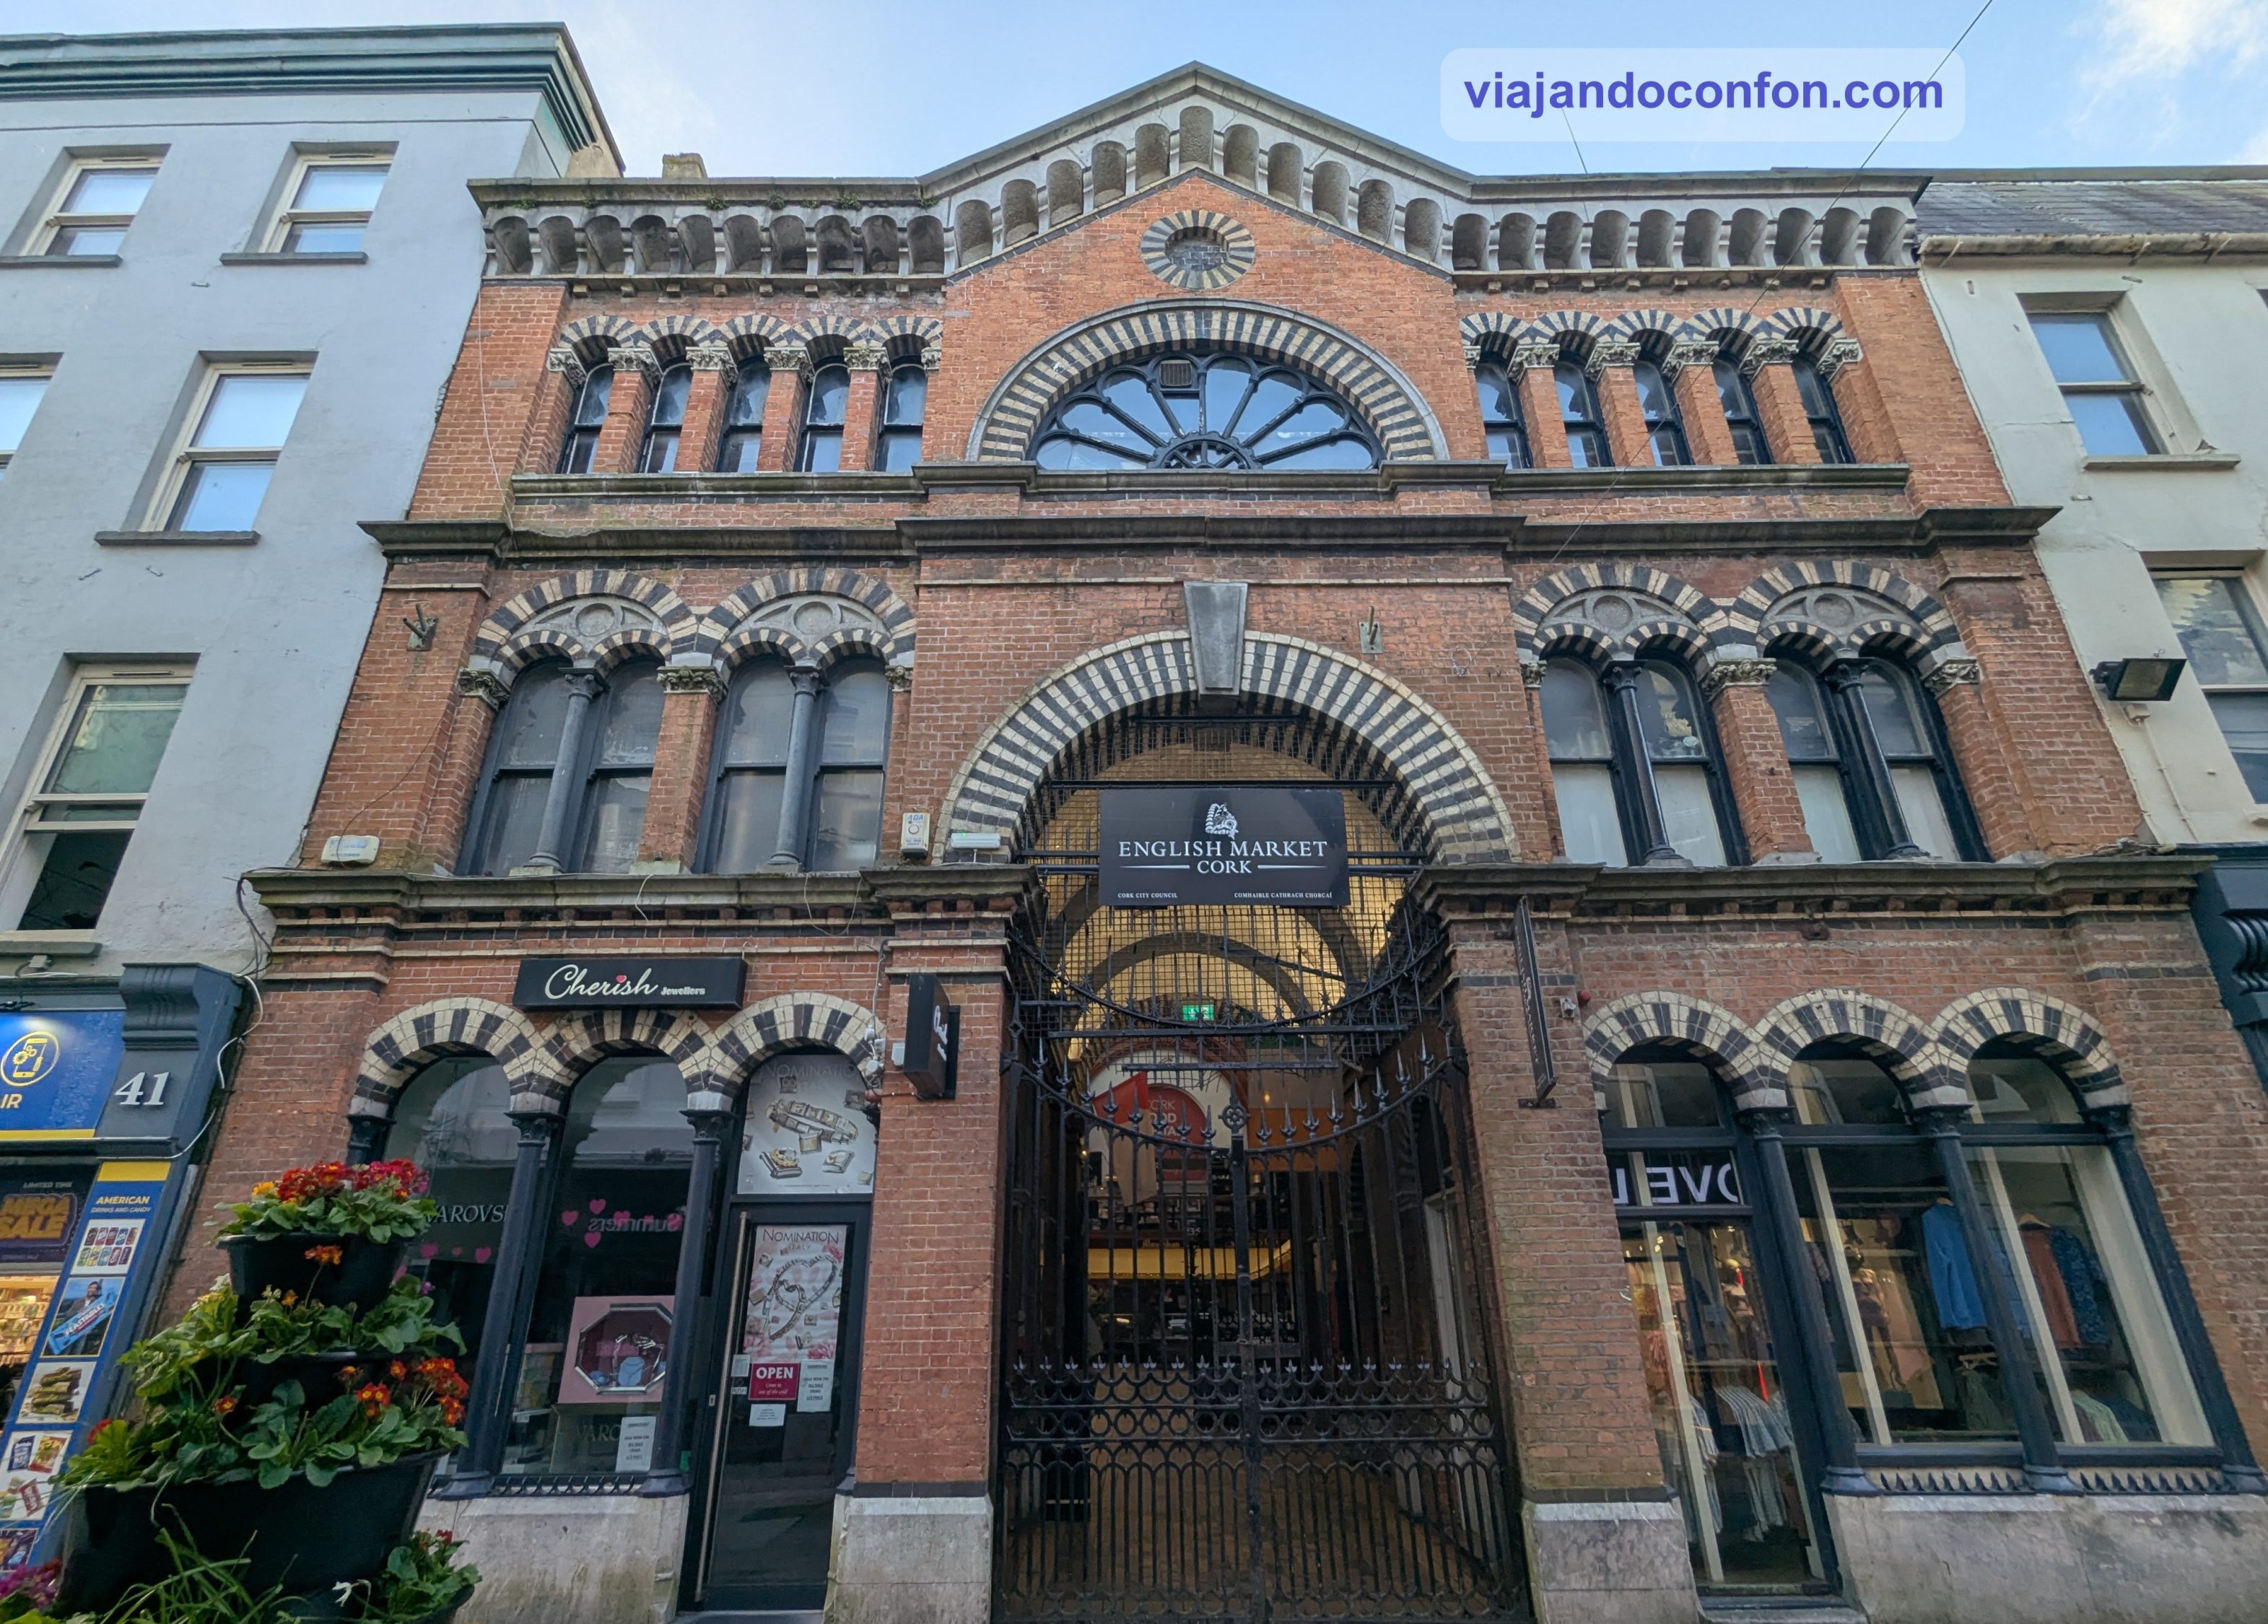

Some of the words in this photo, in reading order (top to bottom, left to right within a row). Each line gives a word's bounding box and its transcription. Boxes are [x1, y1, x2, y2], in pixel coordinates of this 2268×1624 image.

[1118, 841, 1222, 857] ENGLISH
[1229, 841, 1327, 857] MARKET
[1197, 860, 1252, 874] CORK
[544, 964, 659, 1000] Cherish
[660, 986, 706, 996] Jewellers
[114, 1072, 172, 1106] 41
[96, 1196, 150, 1205] AMERICAN
[763, 1228, 839, 1245] NOMINATION
[756, 1366, 794, 1379] OPEN
